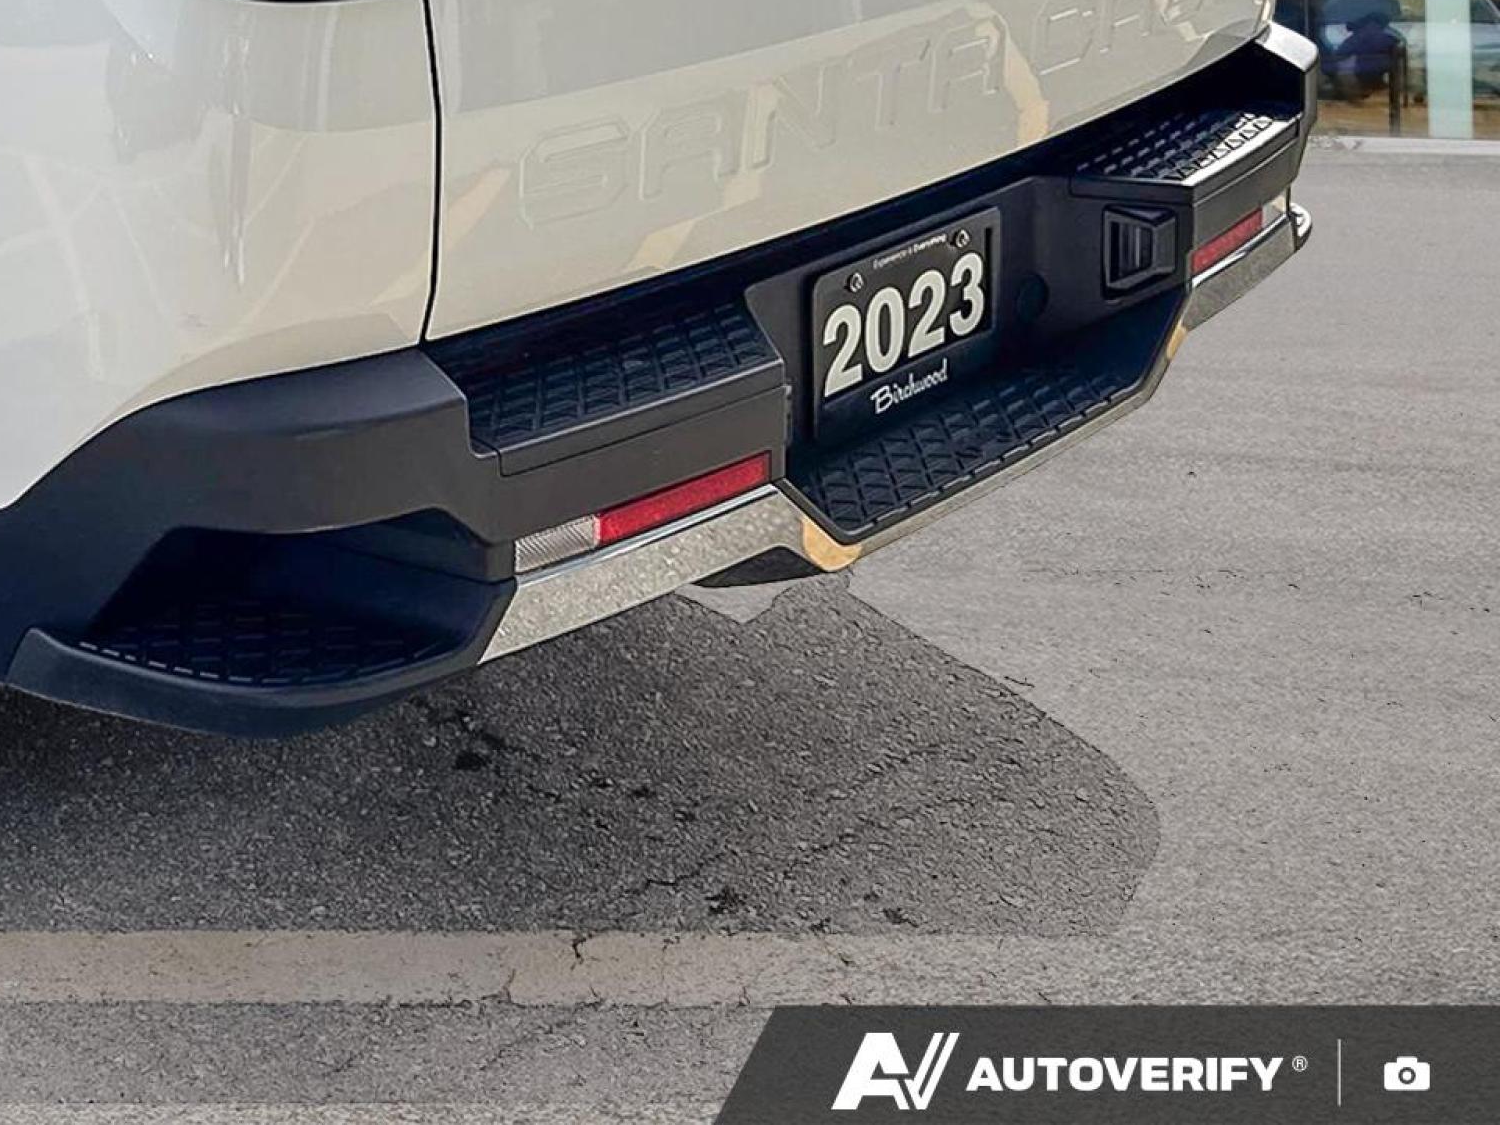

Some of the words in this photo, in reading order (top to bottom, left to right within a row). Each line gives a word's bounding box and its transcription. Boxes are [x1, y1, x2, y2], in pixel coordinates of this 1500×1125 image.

[518, 18, 1008, 230] SANTA
[822, 251, 985, 398] 2023
[869, 357, 948, 415] Birchwood
